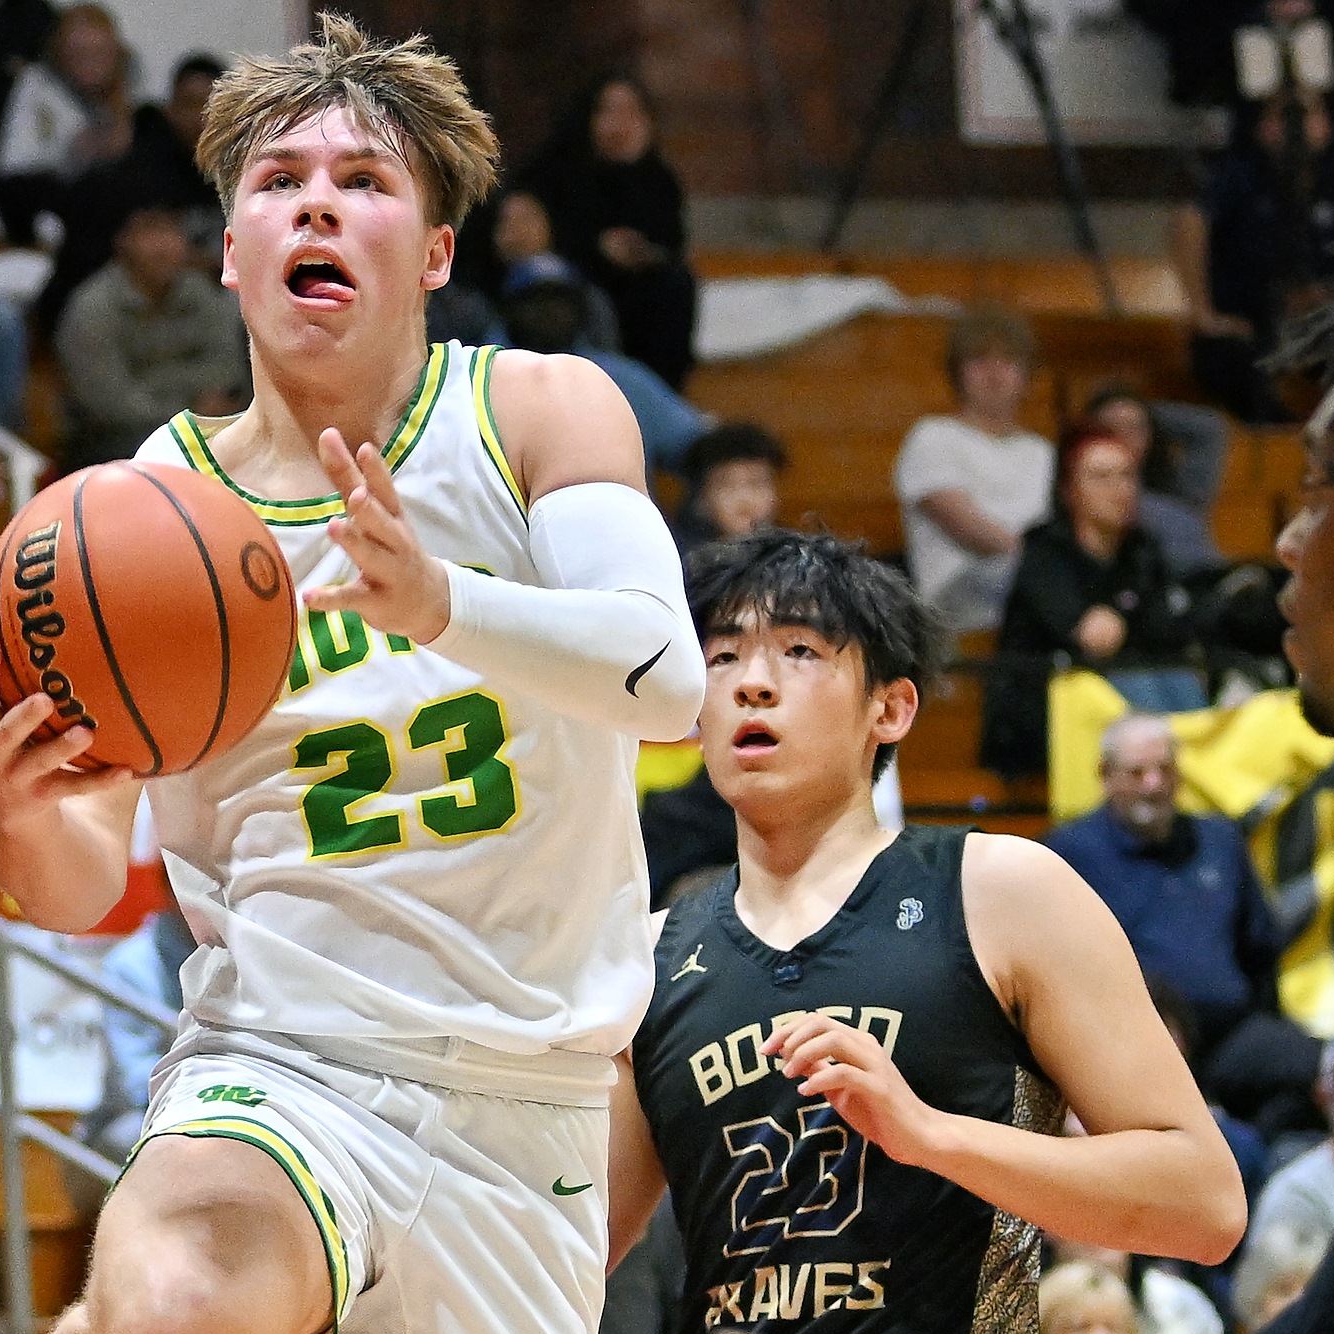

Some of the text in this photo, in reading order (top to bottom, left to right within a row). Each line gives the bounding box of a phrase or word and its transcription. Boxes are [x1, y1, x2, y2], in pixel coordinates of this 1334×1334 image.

[14, 520, 98, 730] Wilson
[288, 687, 522, 863] 23
[722, 1101, 867, 1258] 23
